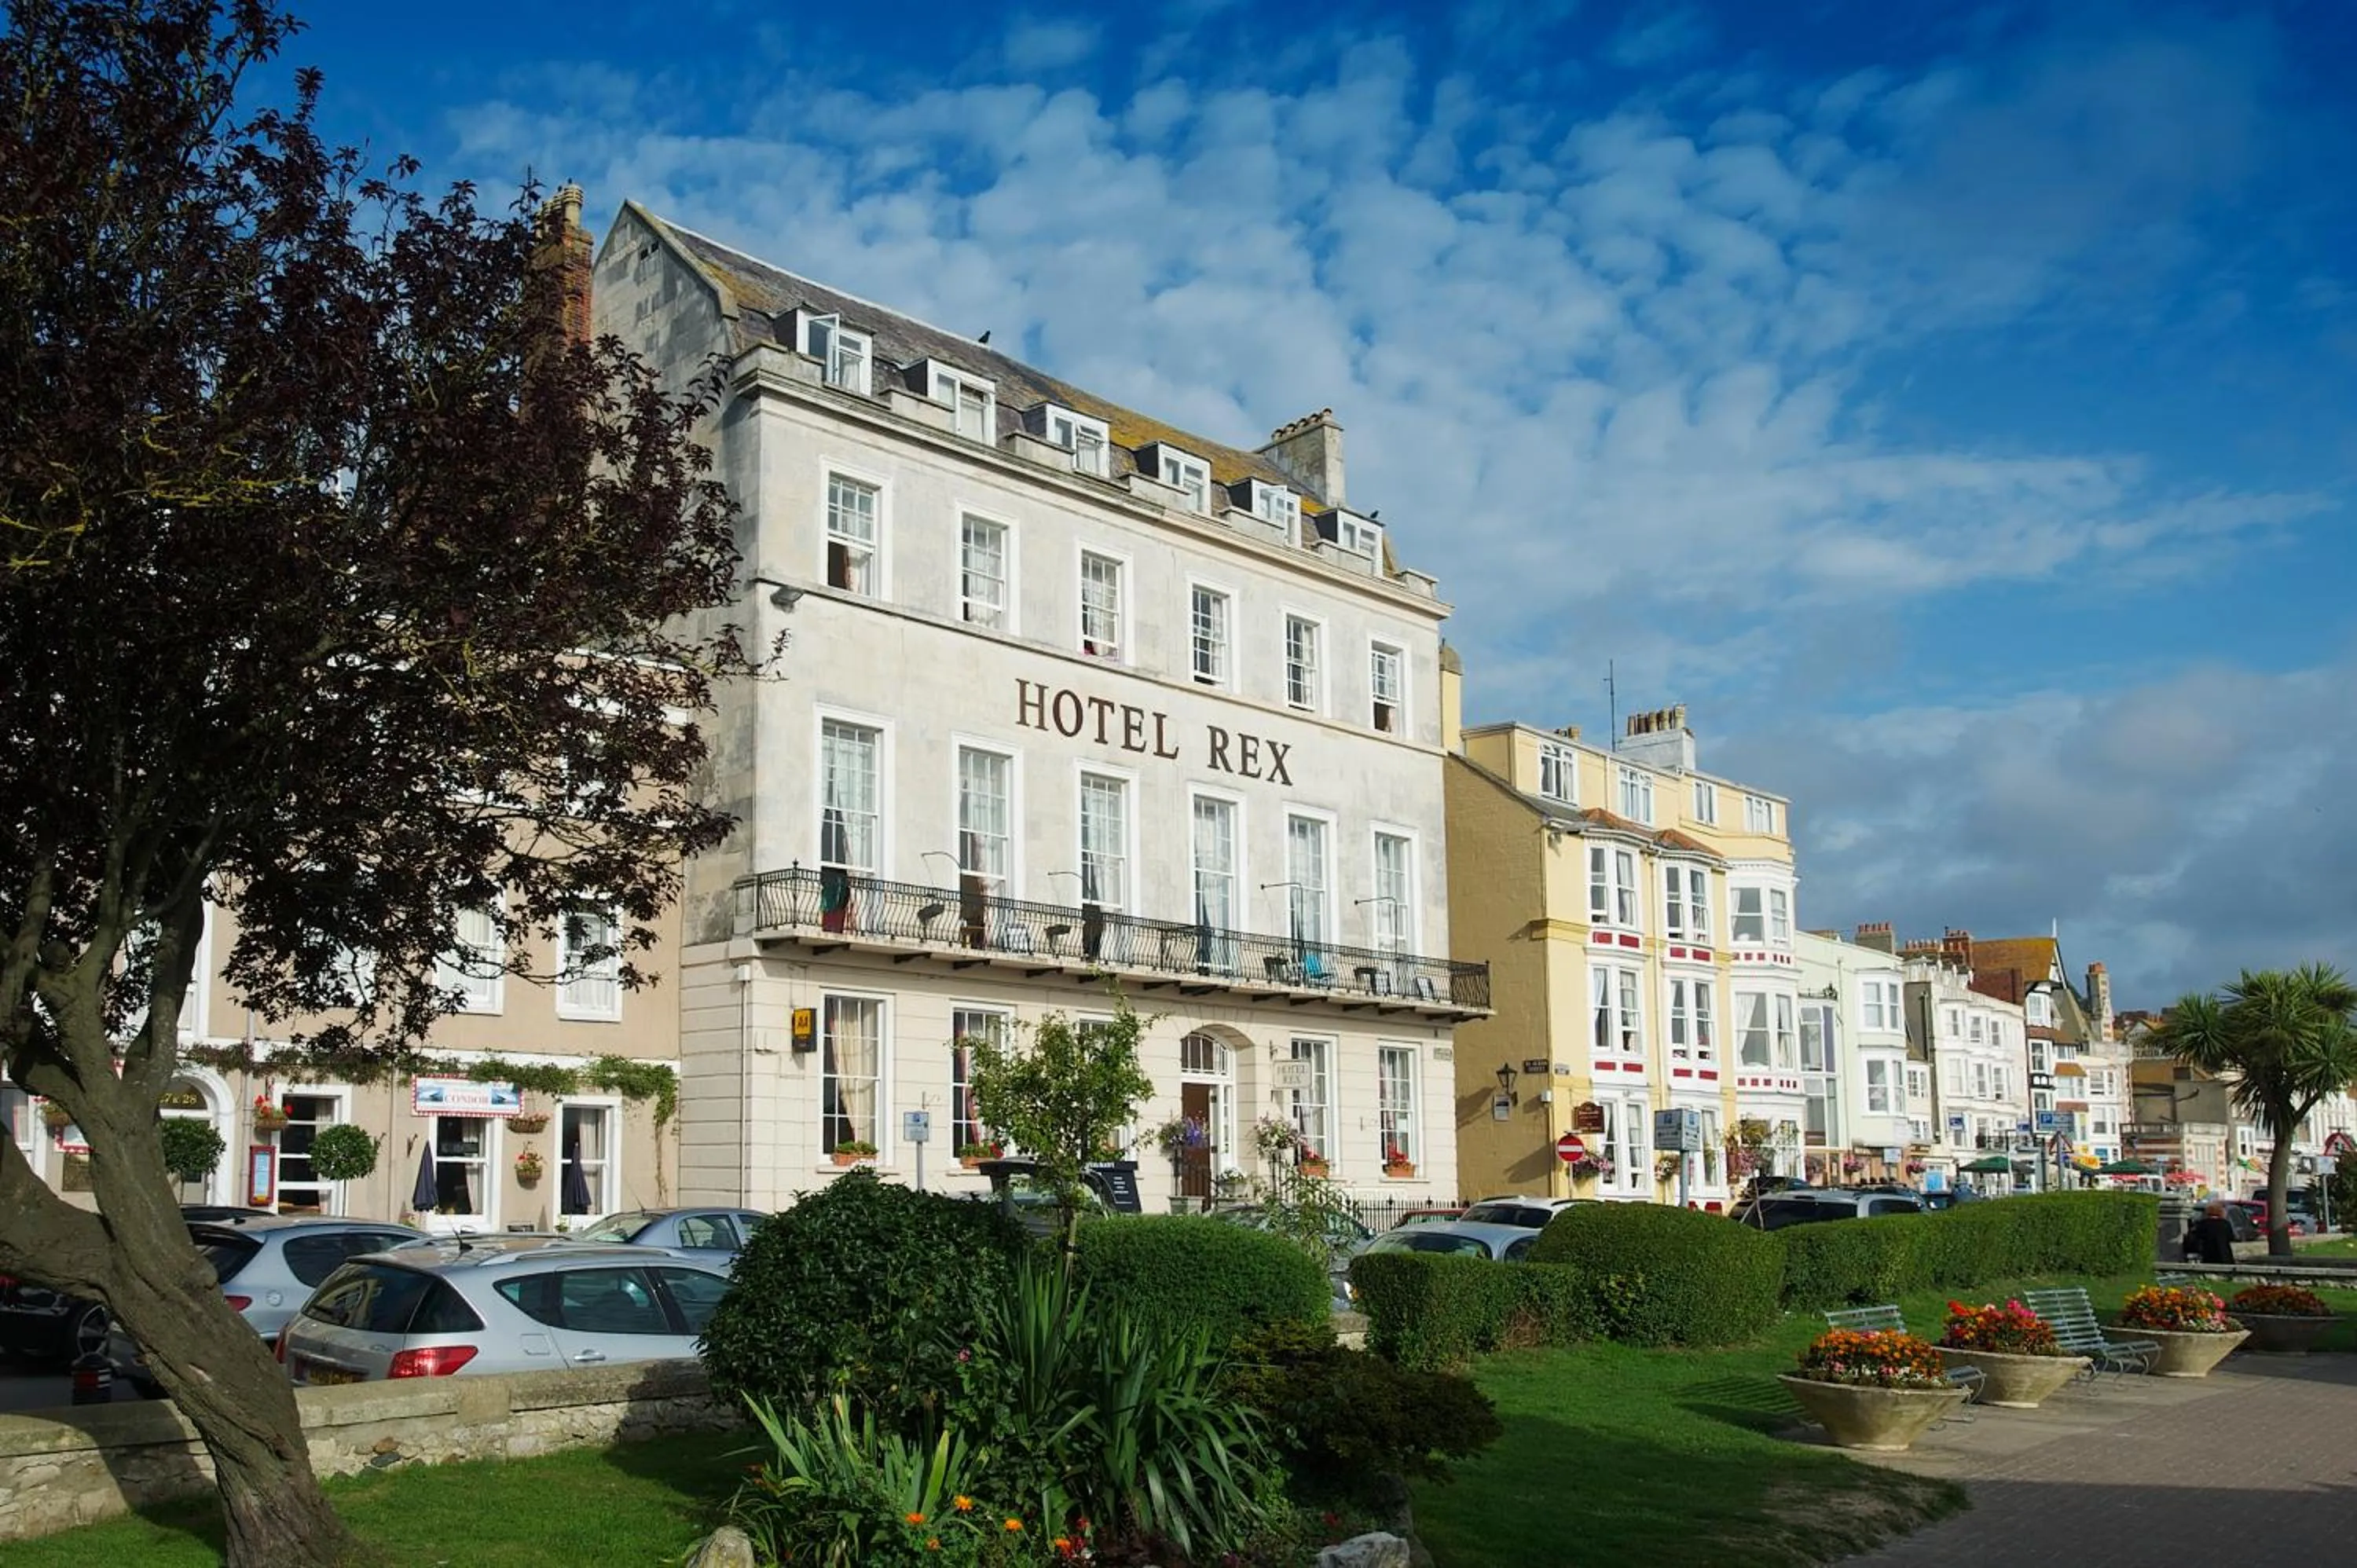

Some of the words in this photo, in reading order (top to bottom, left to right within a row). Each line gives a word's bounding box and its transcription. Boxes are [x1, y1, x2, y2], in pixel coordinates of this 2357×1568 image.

[1015, 678, 1179, 760] HOTEL
[1207, 725, 1293, 786] REX
[1277, 1064, 1307, 1075] HOTEL
[1282, 1075, 1301, 1084] REX
[182, 1093, 197, 1105] 28
[444, 1093, 489, 1105] CONDOR
